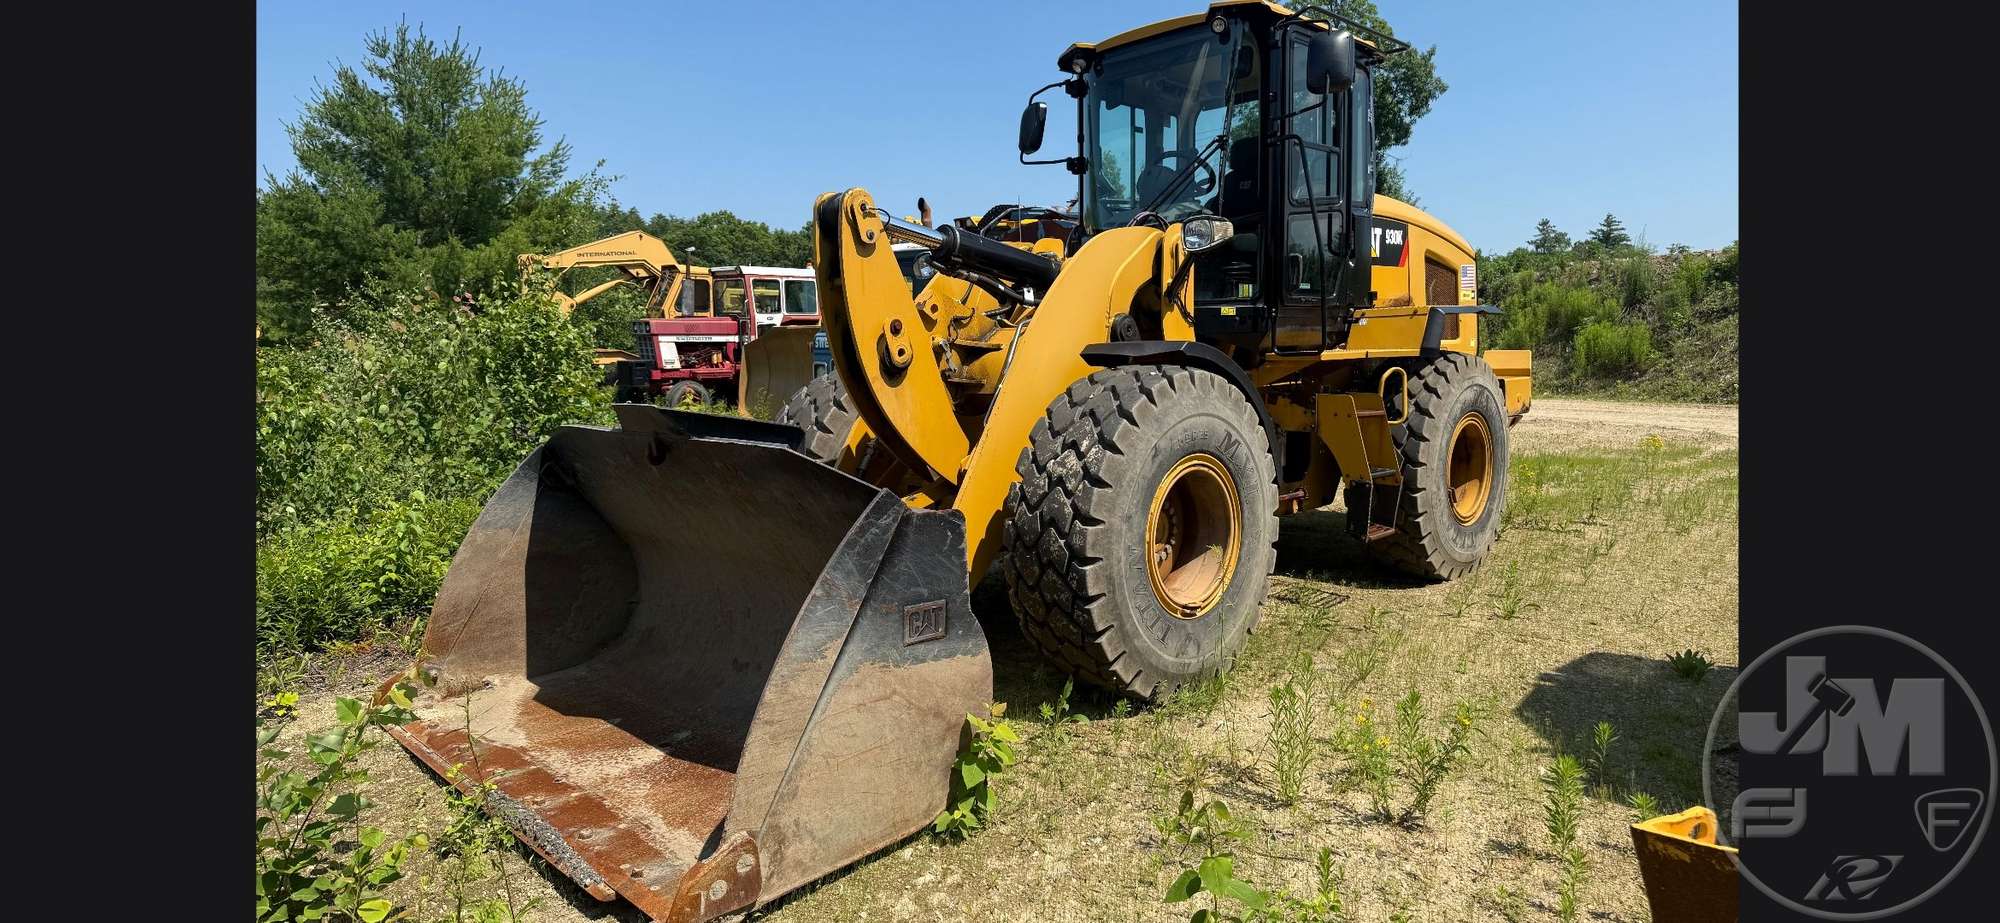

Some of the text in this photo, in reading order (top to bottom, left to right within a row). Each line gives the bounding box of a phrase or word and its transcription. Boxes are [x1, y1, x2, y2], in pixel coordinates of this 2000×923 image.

[1385, 229, 1404, 245] 930K
[576, 250, 638, 258] INTERNATIONAL
[908, 606, 944, 640] CAT
